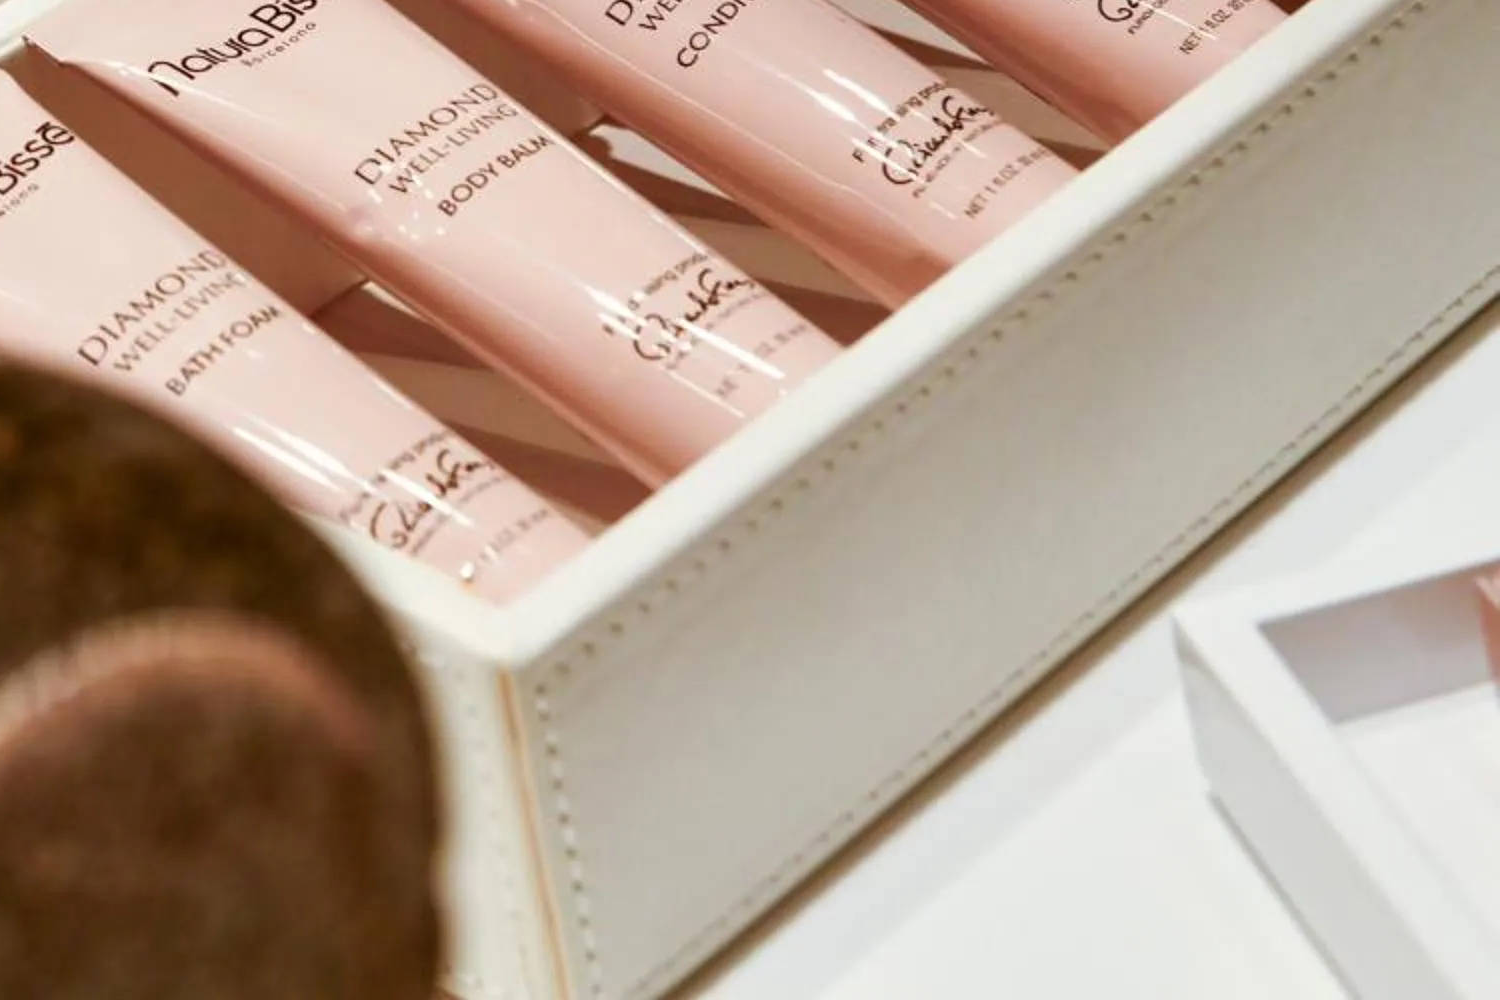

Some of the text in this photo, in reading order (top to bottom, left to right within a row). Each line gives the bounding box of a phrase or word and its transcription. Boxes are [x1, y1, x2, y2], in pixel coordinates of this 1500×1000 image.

[353, 83, 499, 186] DIAMOND
[388, 103, 520, 194] WELL-LIVING
[437, 134, 555, 217] BODY BALM
[77, 250, 227, 366] DIAMOND
[165, 304, 280, 396] BATH FOAM
